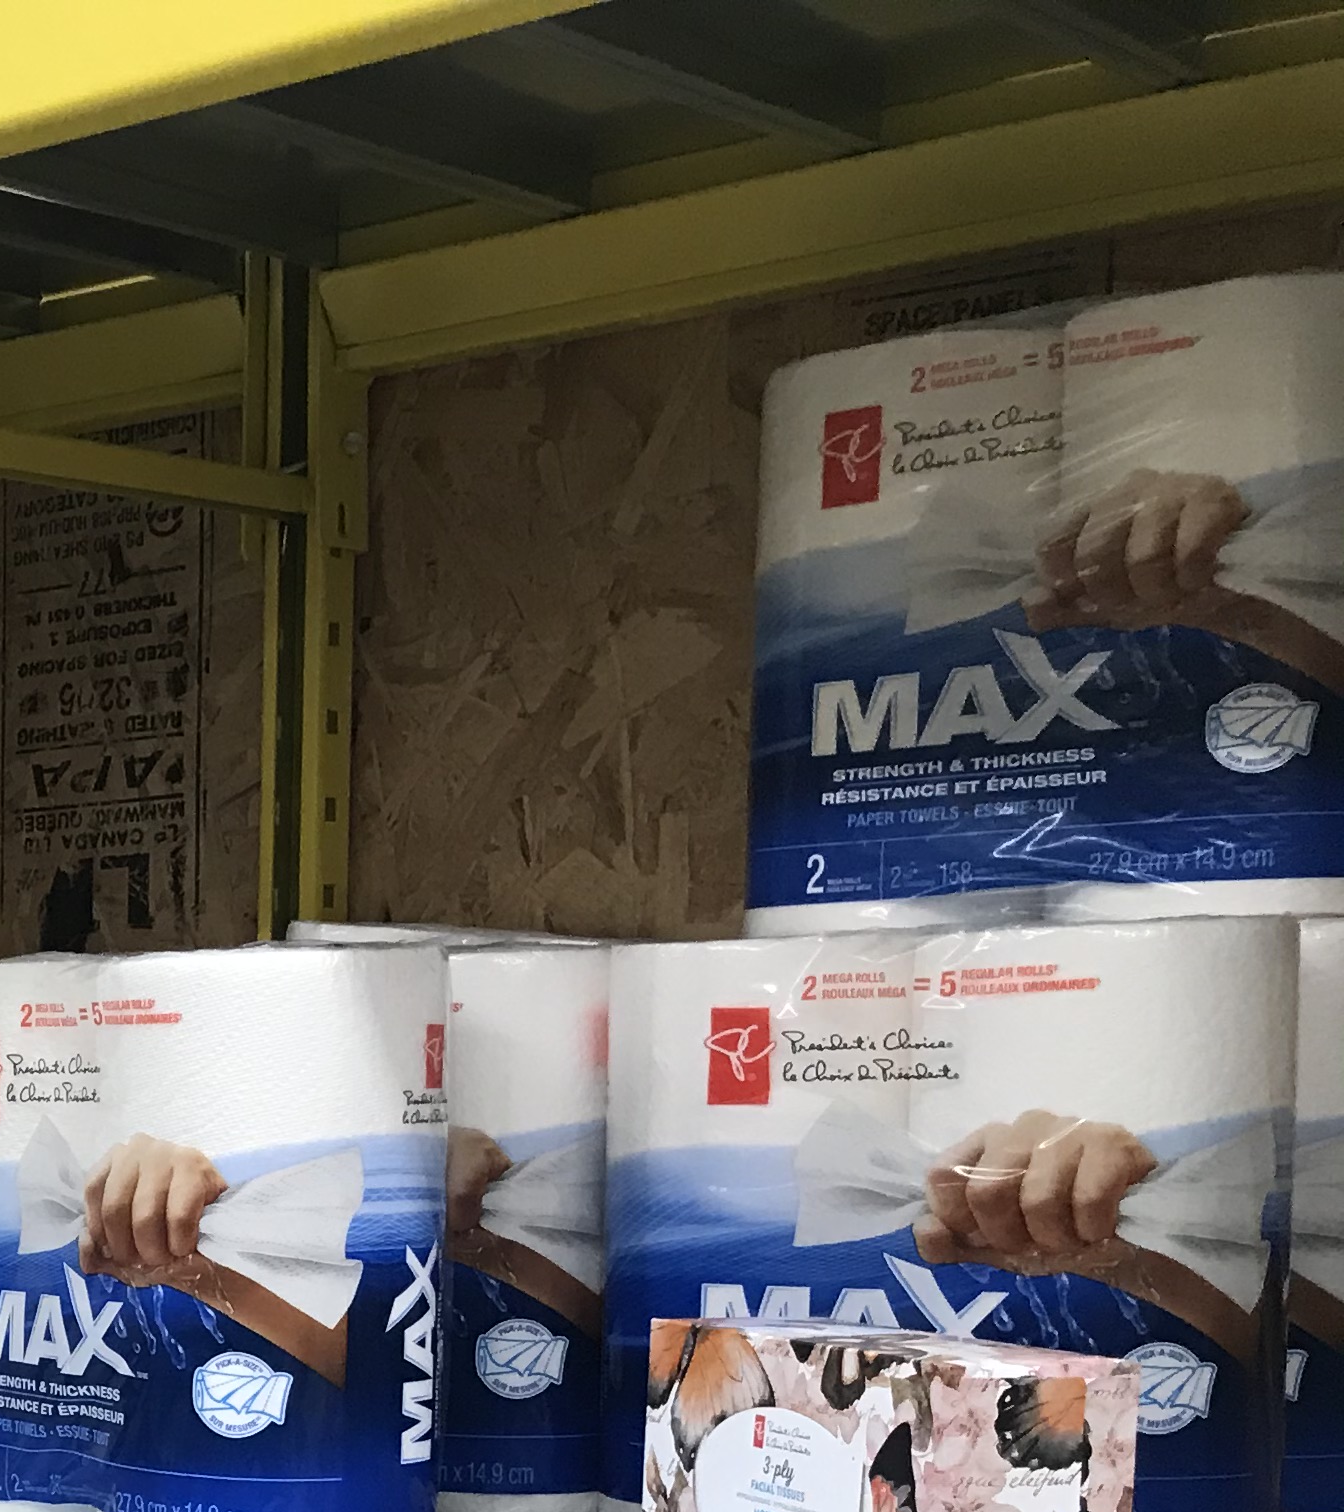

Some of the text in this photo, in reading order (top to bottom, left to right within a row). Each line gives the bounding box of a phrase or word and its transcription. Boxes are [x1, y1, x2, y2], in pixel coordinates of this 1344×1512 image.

[911, 367, 926, 393] 2
[812, 627, 1122, 756] MAX
[833, 748, 1095, 782] STRENGTH & THICKNESS
[822, 770, 1107, 805] RÉSISTANCE ET ÉPAISSEUR
[848, 803, 958, 828] PAPER TOWELS
[1241, 847, 1275, 869] cm
[806, 854, 825, 894] 2
[801, 976, 817, 1000] 2
[856, 972, 885, 983] ROLLS
[822, 987, 874, 1000] ROULEAUX
[939, 971, 957, 997] 5
[21, 1004, 32, 1027] 2
[92, 1002, 102, 1025] 5
[803, 1060, 852, 1082] Choix
[384, 1239, 439, 1464] MAX
[39, 1381, 46, 1393] &
[49, 1382, 120, 1402] THICKNESS
[41, 1403, 53, 1415] ET
[58, 1402, 124, 1425] ÉPAISSEUR
[14, 1421, 46, 1438] TOWELS
[57, 1425, 110, 1447] ESSUIE-TOUT
[468, 1462, 534, 1484] 14.9 cm
[763, 1455, 795, 1487] 3-ply
[751, 1479, 805, 1502] FACIAL TISSUES
